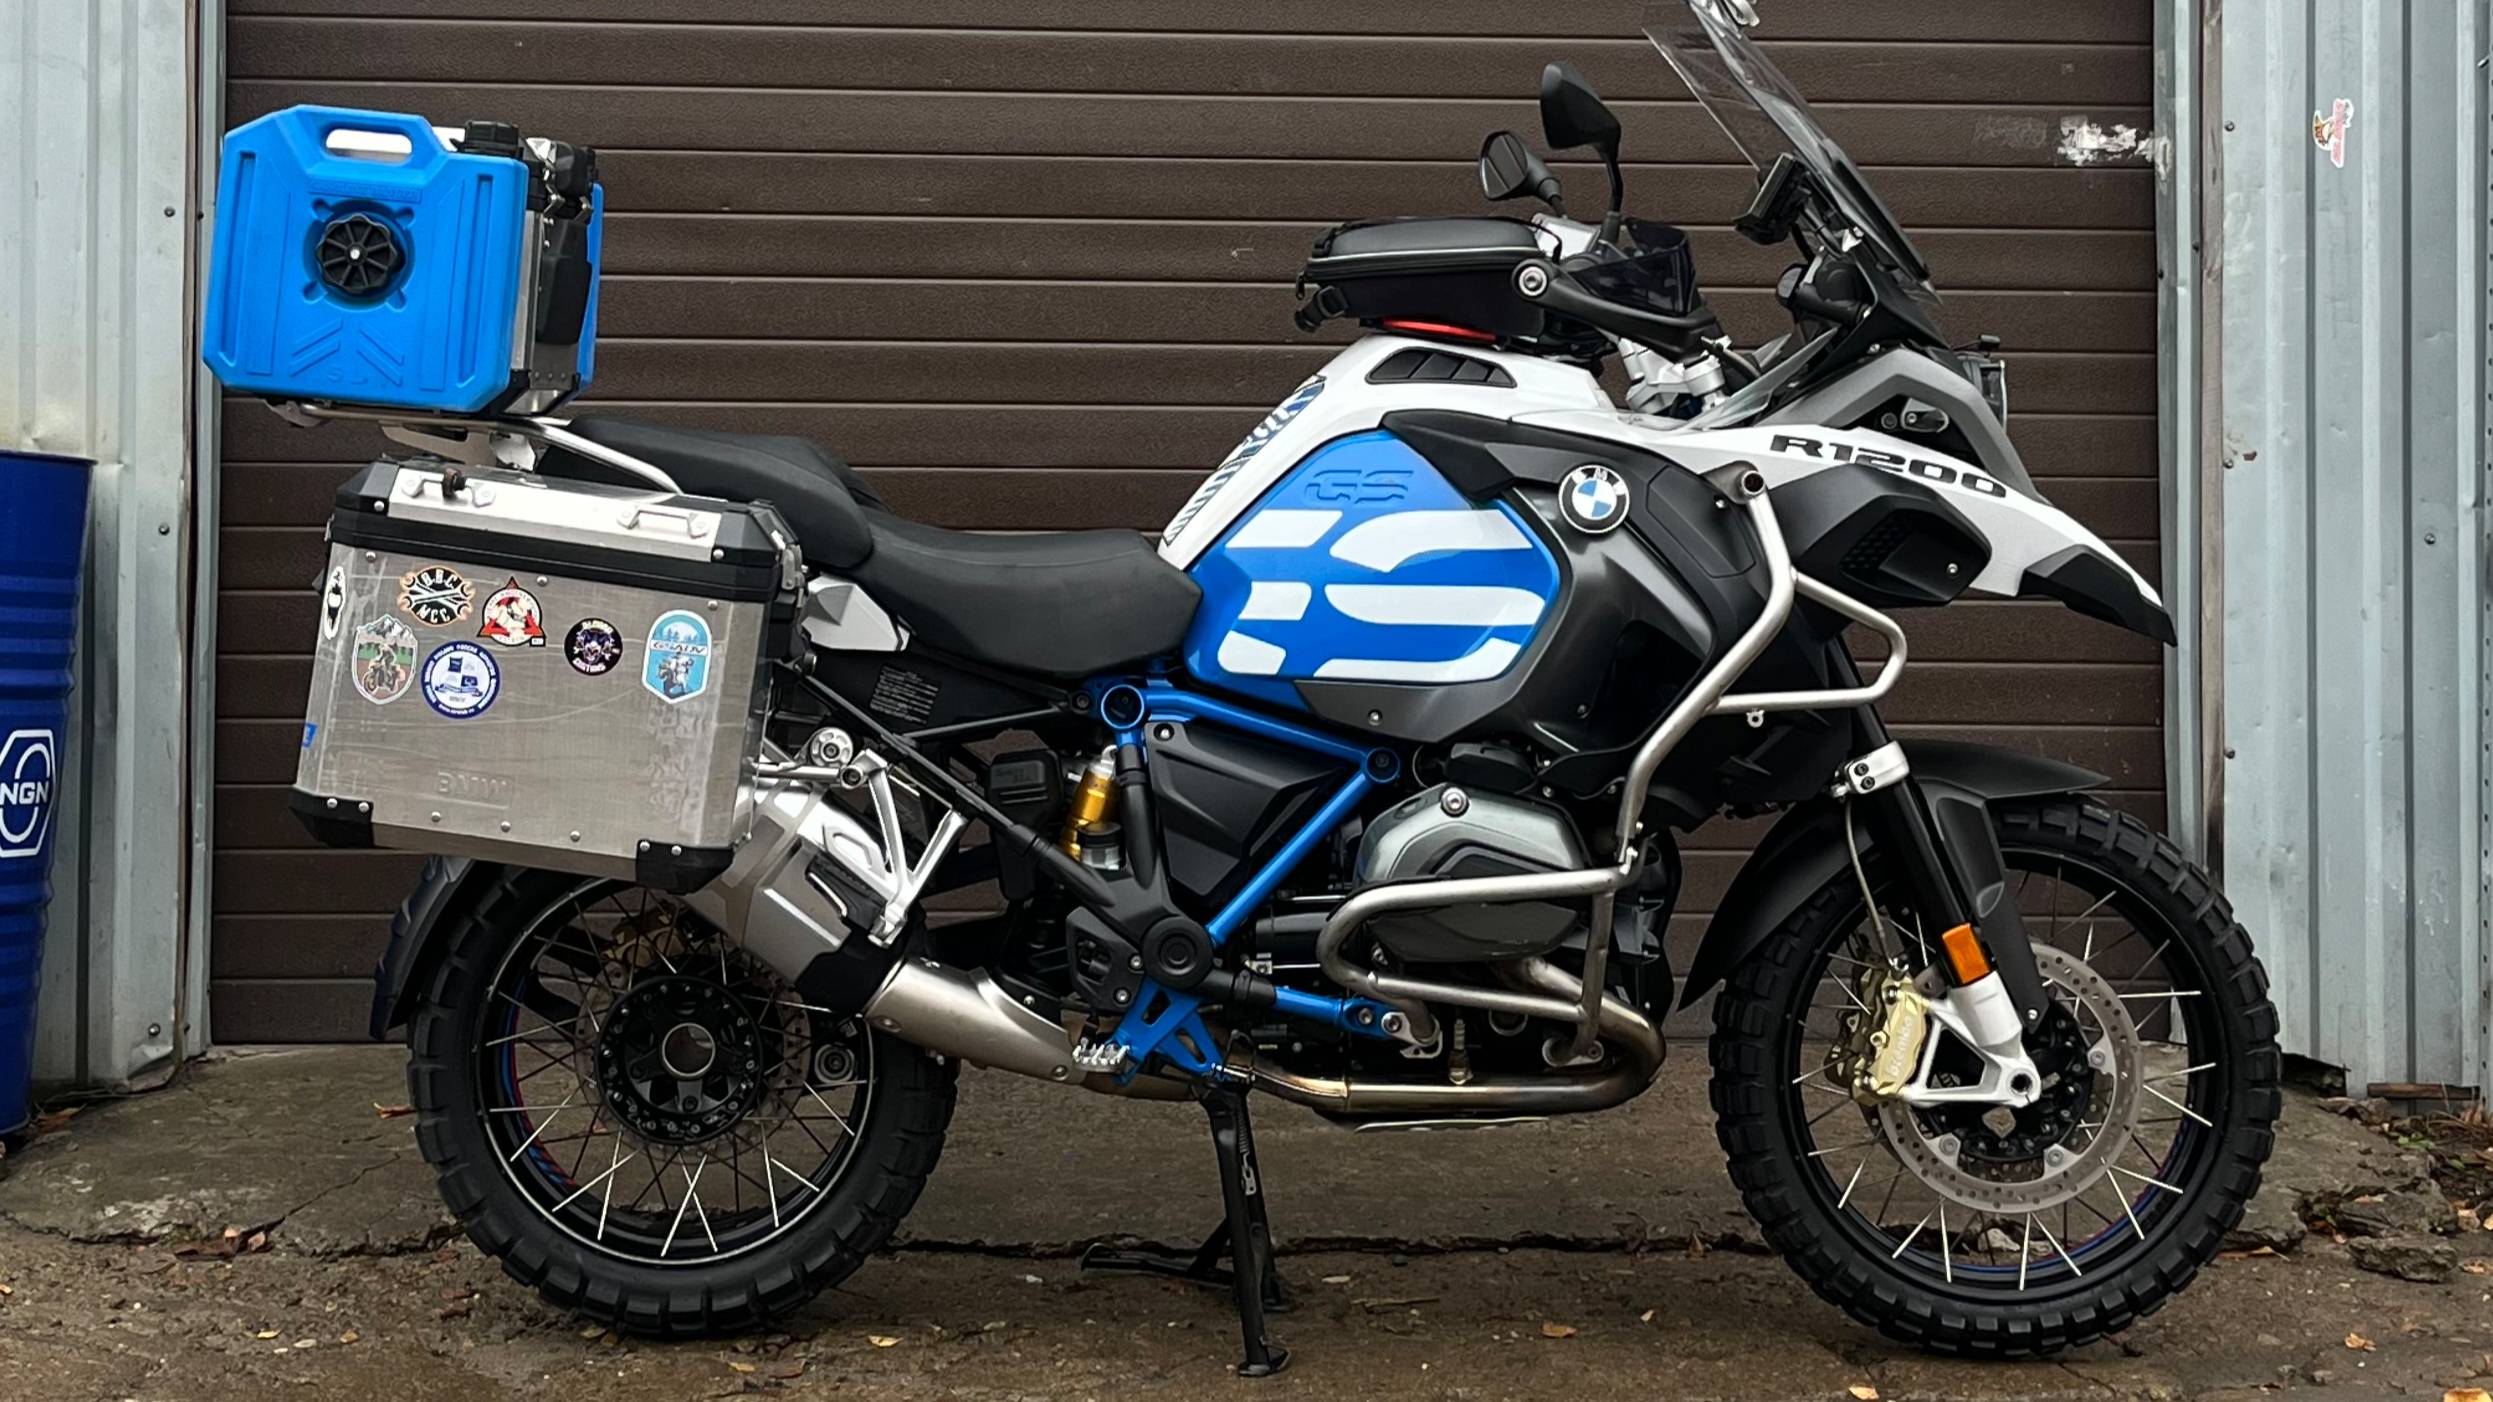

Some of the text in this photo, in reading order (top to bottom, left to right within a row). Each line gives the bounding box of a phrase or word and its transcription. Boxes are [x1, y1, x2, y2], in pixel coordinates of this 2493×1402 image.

[1570, 466, 1627, 496] BMW
[1770, 434, 2007, 497] R1200
[1303, 469, 1415, 504] GS
[0, 780, 49, 806] NGN
[1888, 1017, 1913, 1077] brembo
